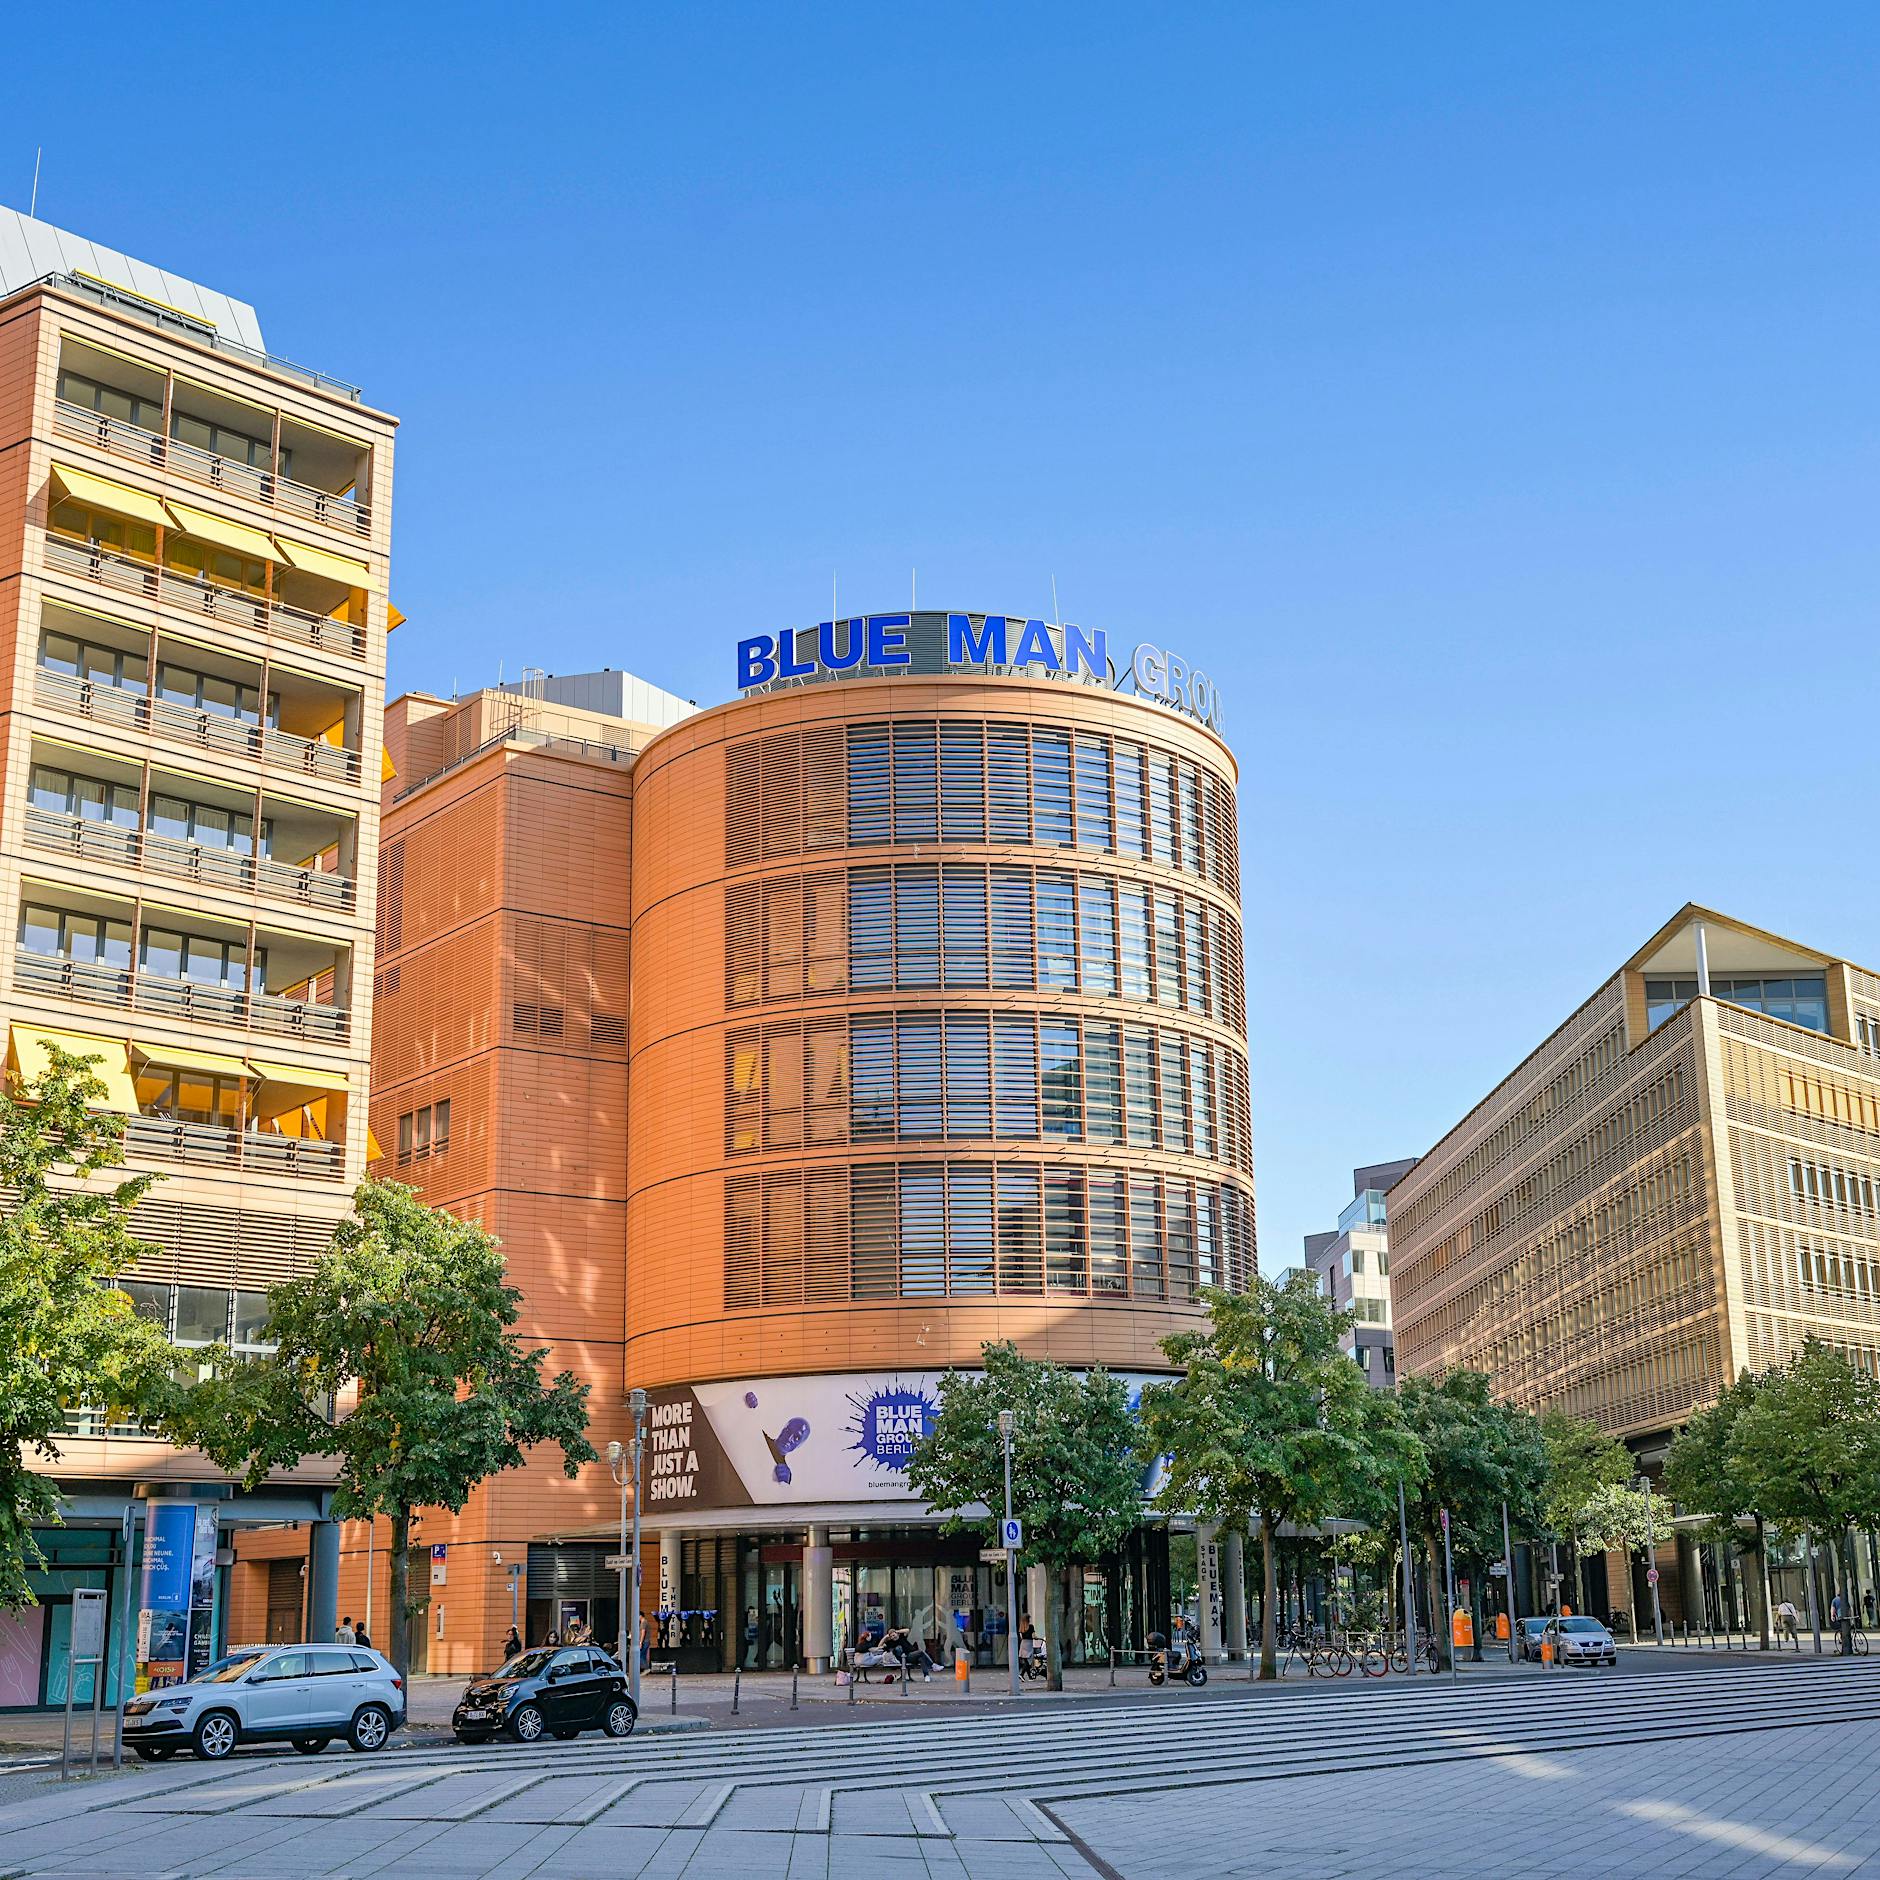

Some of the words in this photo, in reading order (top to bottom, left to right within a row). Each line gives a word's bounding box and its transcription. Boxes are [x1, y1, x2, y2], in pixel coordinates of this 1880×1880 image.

[737, 614, 912, 690] BLUE
[947, 614, 1108, 679] MAN
[1133, 643, 1225, 736] GROU
[651, 1401, 693, 1428] MORE
[875, 1405, 922, 1419] BLUE
[651, 1426, 690, 1452] THAN
[875, 1418, 923, 1434] MAN
[650, 1451, 684, 1477] JUST
[685, 1450, 700, 1472] A
[650, 1475, 697, 1501] SHOW.
[660, 1555, 669, 1613] BLUEM
[950, 1574, 976, 1584] BLU
[1208, 1545, 1219, 1627] BLUEMAX
[950, 1592, 977, 1600] GROU
[950, 1599, 976, 1607] BERLI
